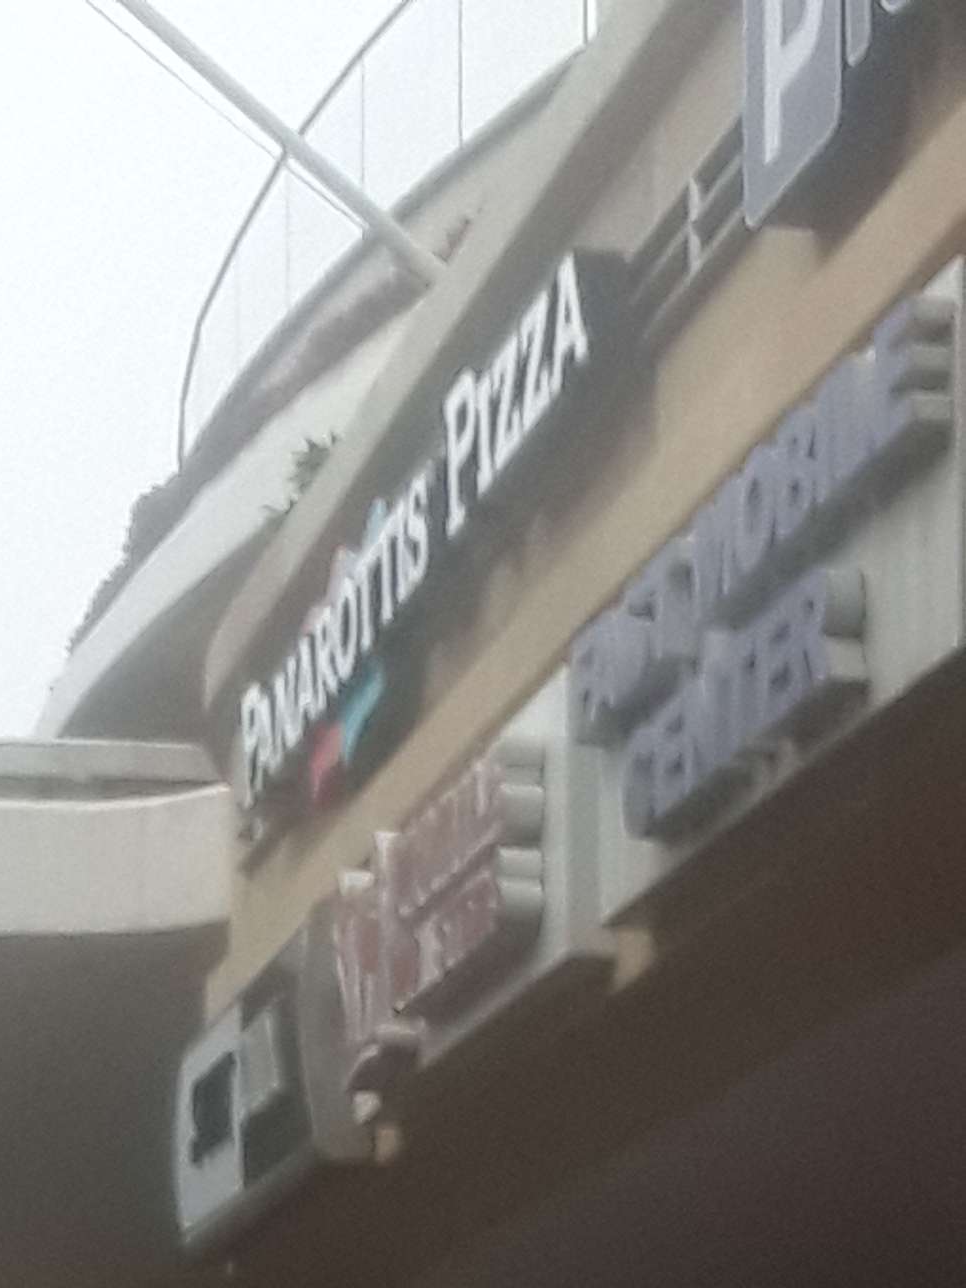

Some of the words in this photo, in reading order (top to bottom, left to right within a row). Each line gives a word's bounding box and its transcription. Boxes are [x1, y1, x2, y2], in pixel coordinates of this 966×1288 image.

[239, 472, 432, 808] PANAROTTIS
[442, 250, 589, 540] PIZZA
[691, 298, 919, 622] MOBILE
[622, 568, 832, 840] CENTER
